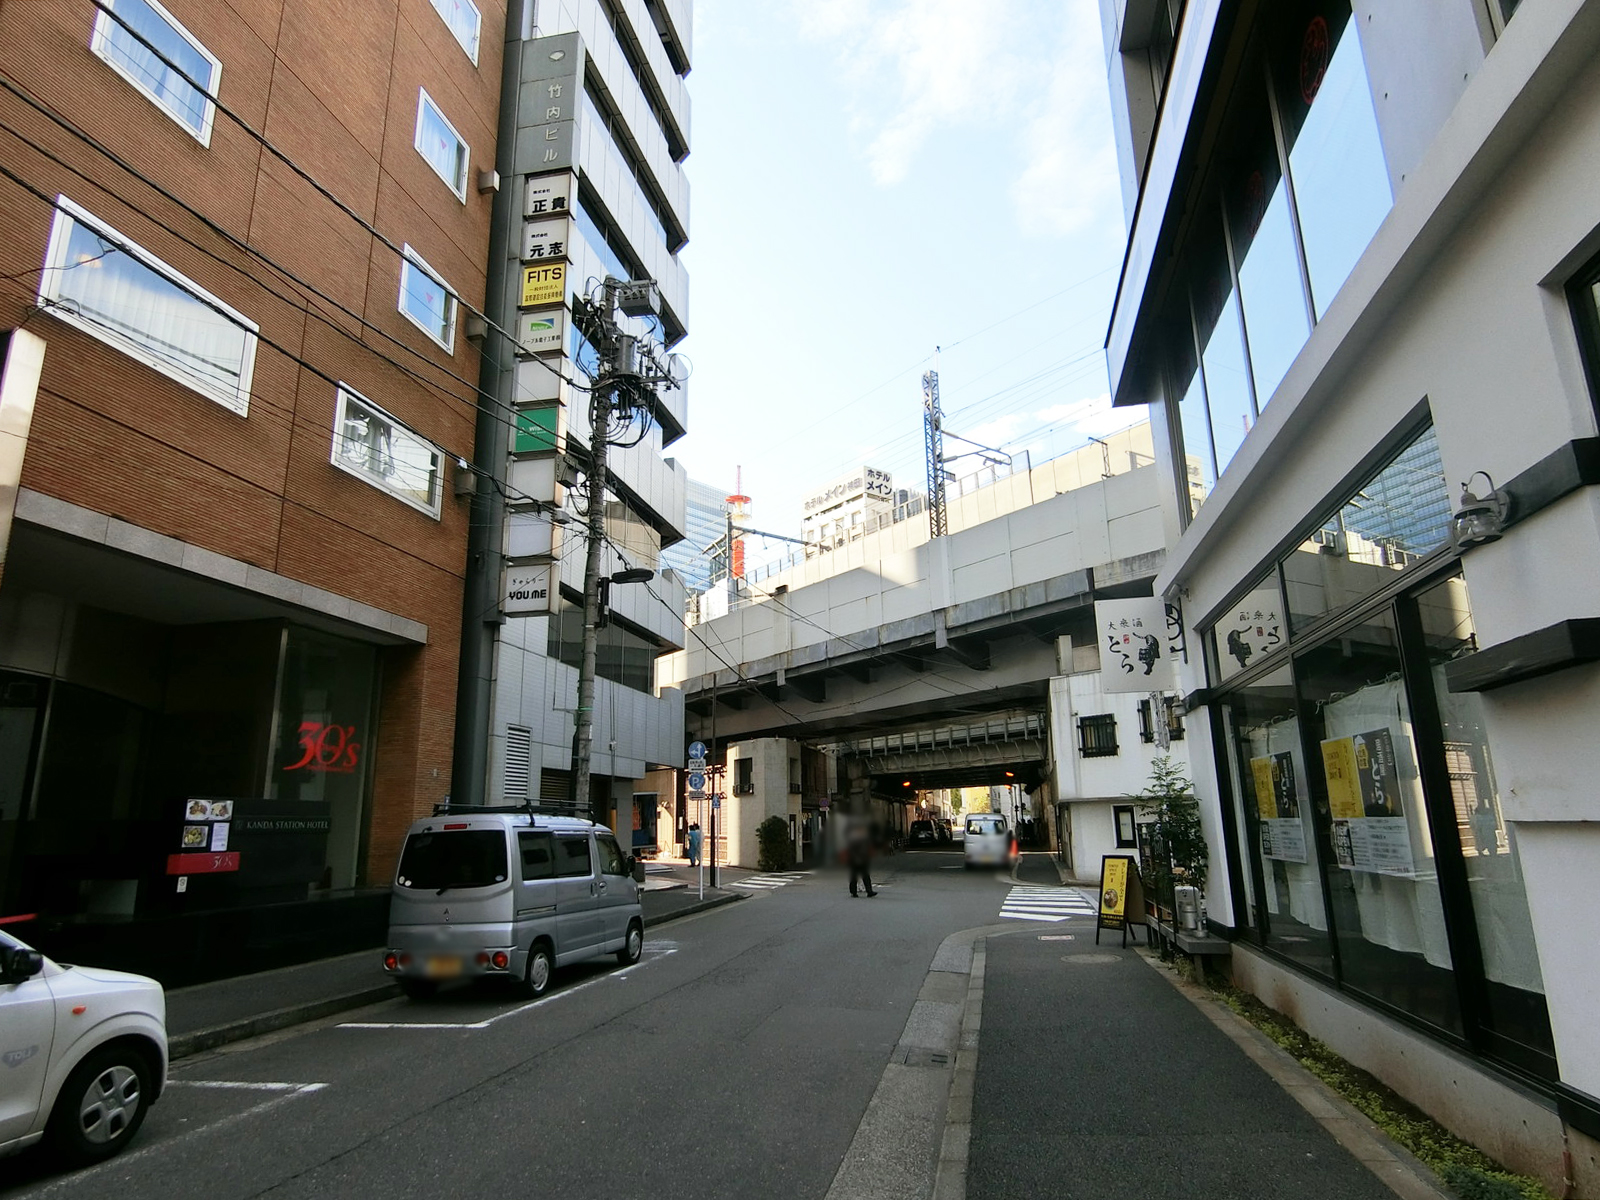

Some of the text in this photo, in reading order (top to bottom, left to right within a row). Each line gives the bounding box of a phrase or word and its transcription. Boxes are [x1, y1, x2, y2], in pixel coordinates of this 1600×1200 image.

[543, 84, 562, 162] 竹内ビル
[530, 242, 563, 258] 元志
[528, 267, 562, 283] FITS
[867, 469, 890, 482] ホテル
[866, 480, 893, 496] メイン
[509, 589, 547, 600] YOU ME
[1107, 635, 1135, 675] とら
[282, 721, 361, 770] 30's
[247, 820, 329, 829] KANDA STATION HOTEL
